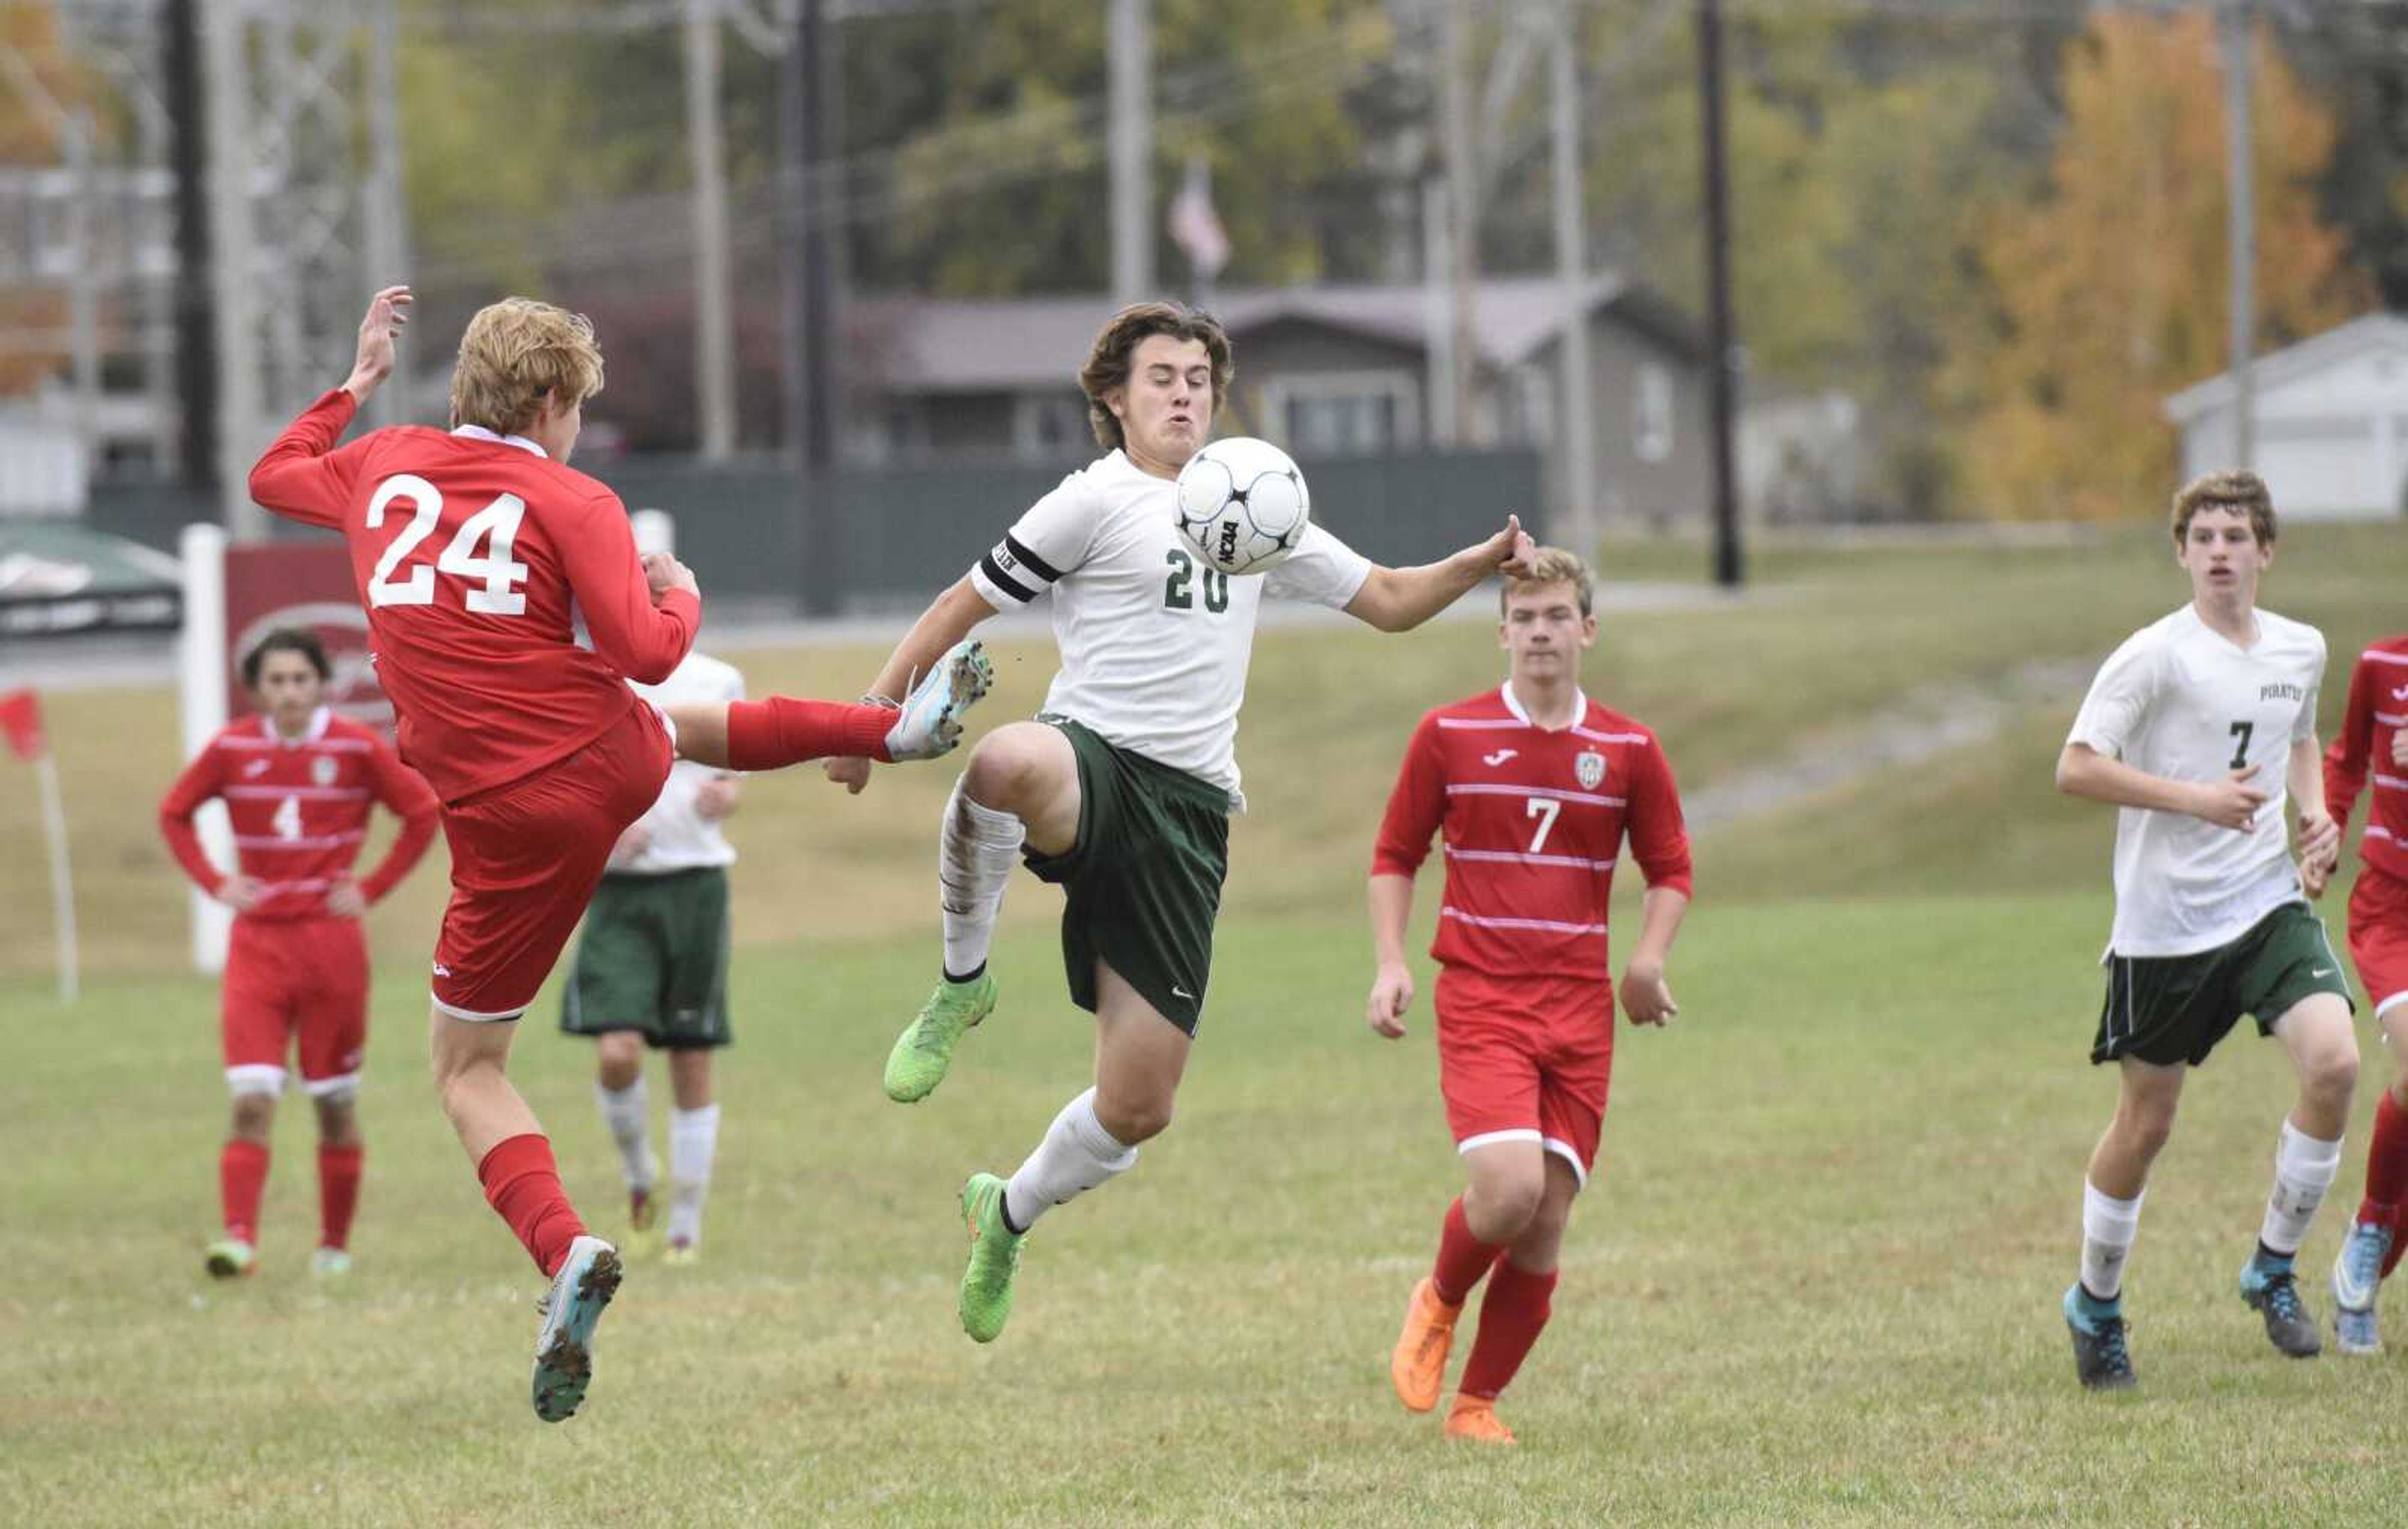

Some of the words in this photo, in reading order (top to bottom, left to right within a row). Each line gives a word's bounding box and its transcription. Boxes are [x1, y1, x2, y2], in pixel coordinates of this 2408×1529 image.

[366, 474, 528, 615] 24
[1218, 521, 1239, 564] NCAA
[1164, 549, 1228, 613] 20
[2230, 722, 2253, 768] 7
[273, 794, 302, 842] 4
[1527, 798, 1560, 853] 7
